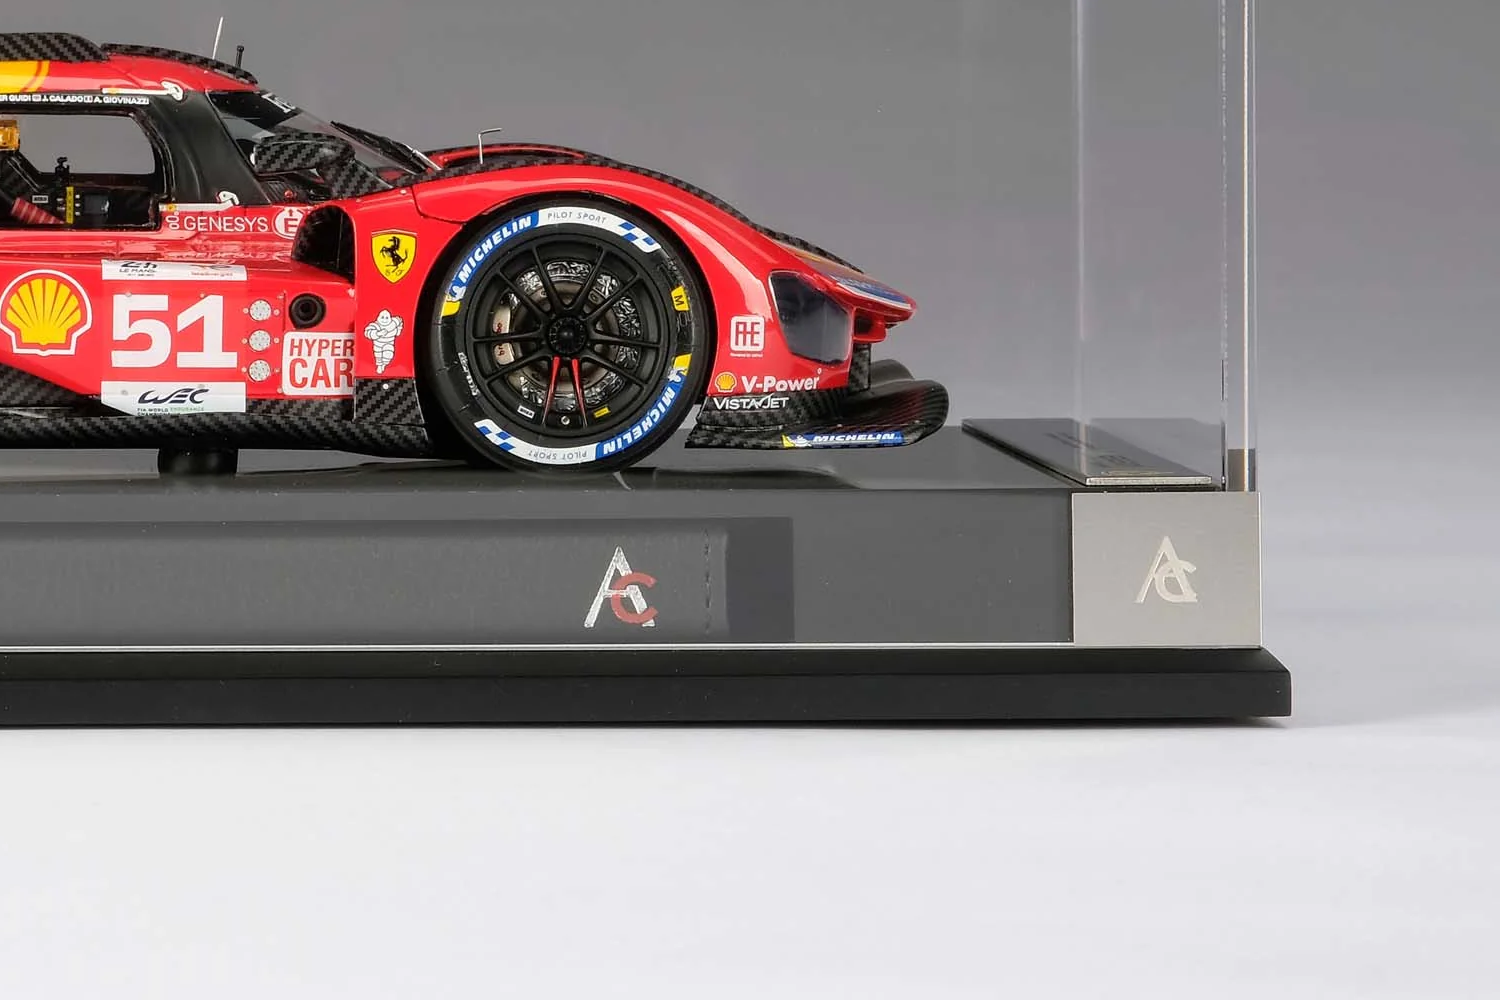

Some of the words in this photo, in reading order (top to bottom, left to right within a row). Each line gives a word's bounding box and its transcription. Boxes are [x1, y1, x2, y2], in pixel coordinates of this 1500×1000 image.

[49, 94, 83, 103] CALADO
[183, 215, 268, 232] GENESYS
[547, 211, 573, 220] PILOT
[576, 212, 607, 224] SPORT
[457, 215, 531, 282] MICHELIN
[673, 294, 685, 306] M
[111, 293, 238, 369] 51
[290, 338, 355, 357] HYPER
[289, 358, 354, 388] CAR
[741, 375, 820, 393] V-Power
[137, 388, 210, 404] WEC
[603, 386, 676, 455] MICHELIN
[812, 433, 895, 441] MICHELIN
[528, 450, 558, 460] SPORT
[562, 450, 588, 460] PILOT
